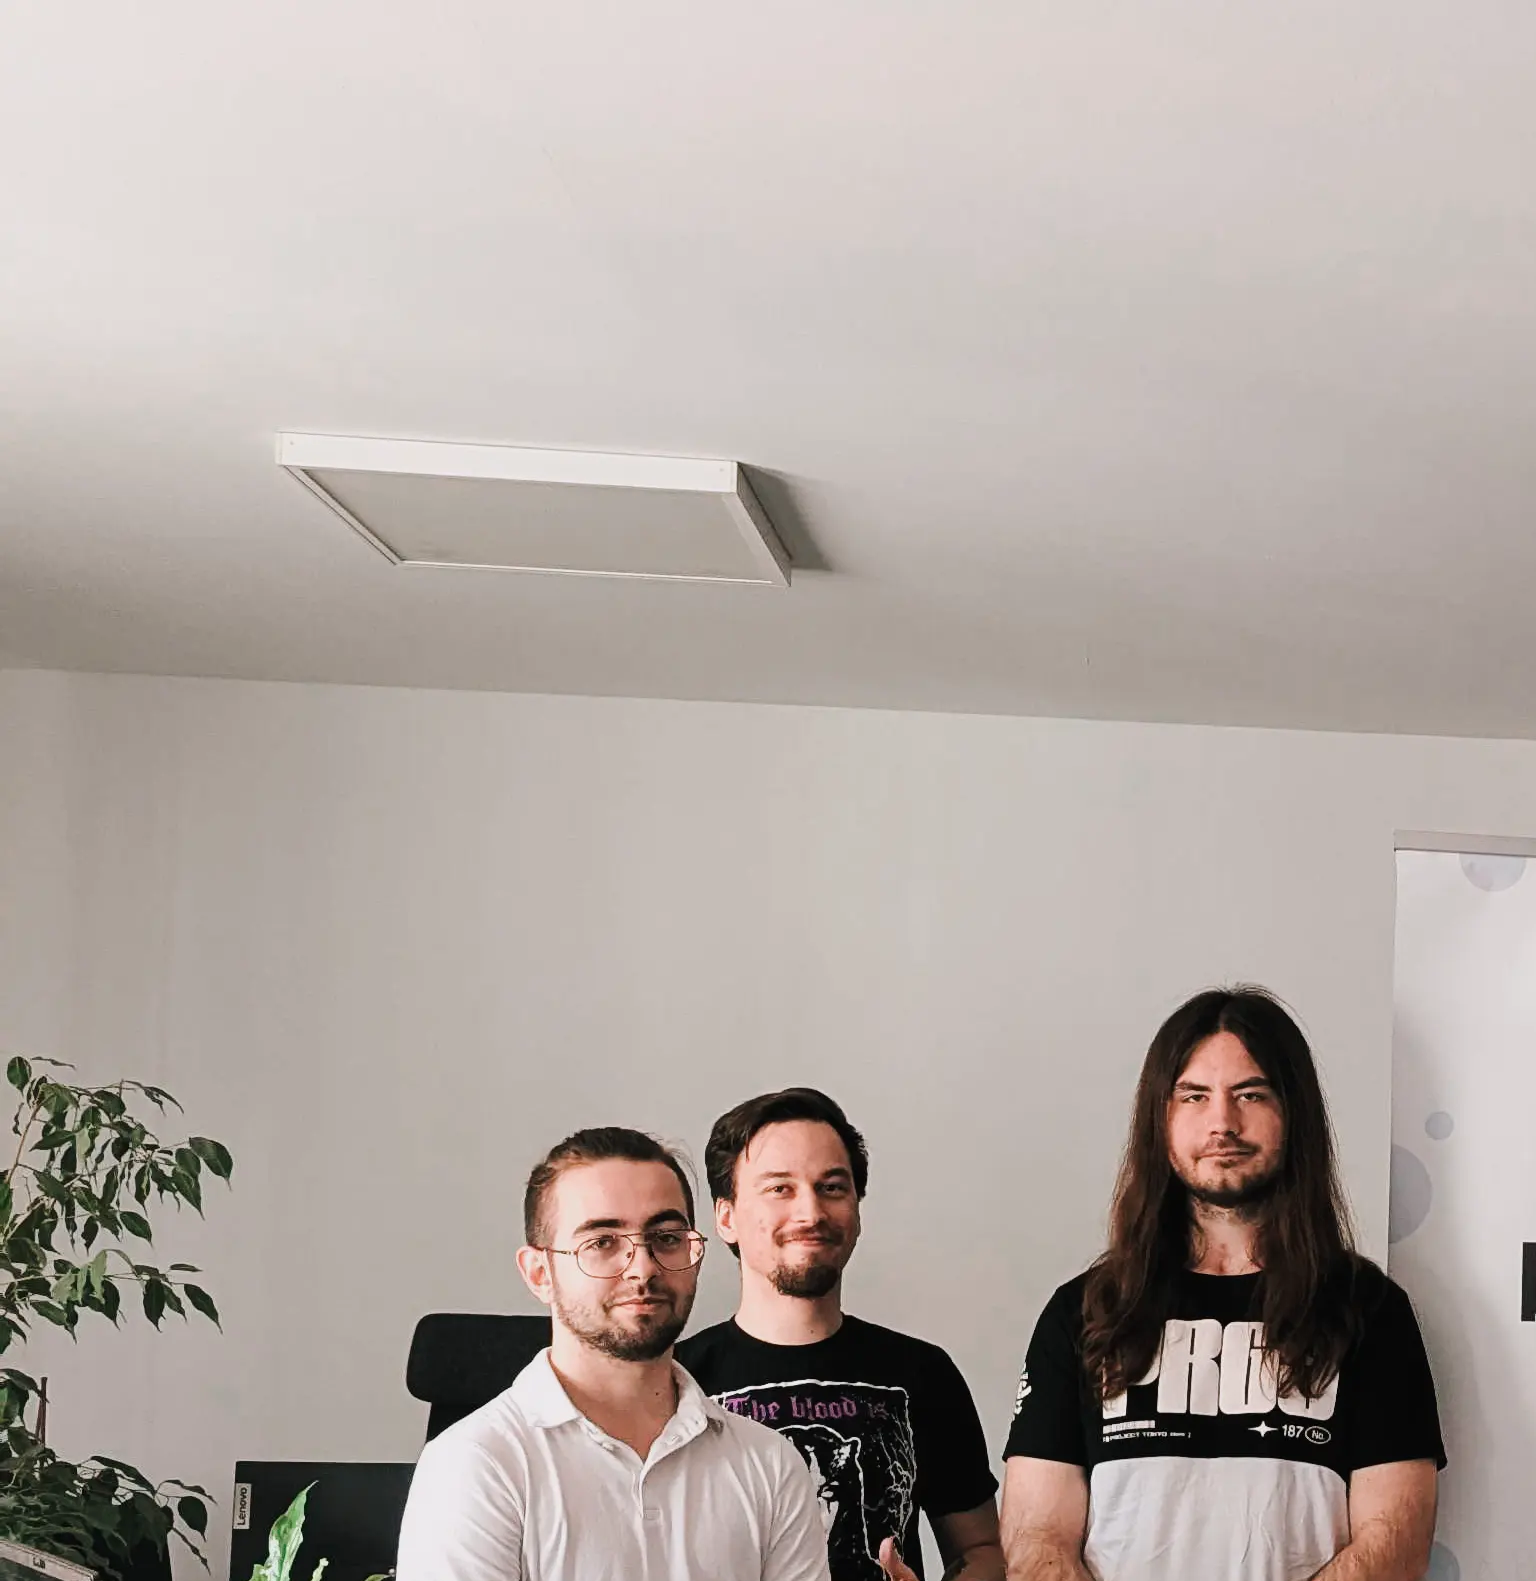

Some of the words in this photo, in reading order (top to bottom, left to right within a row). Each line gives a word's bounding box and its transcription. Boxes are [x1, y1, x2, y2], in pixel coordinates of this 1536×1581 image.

[726, 1395, 780, 1422] The
[791, 1395, 858, 1421] blood
[1282, 1424, 1304, 1438] 187
[237, 1487, 248, 1526] Lenovo
